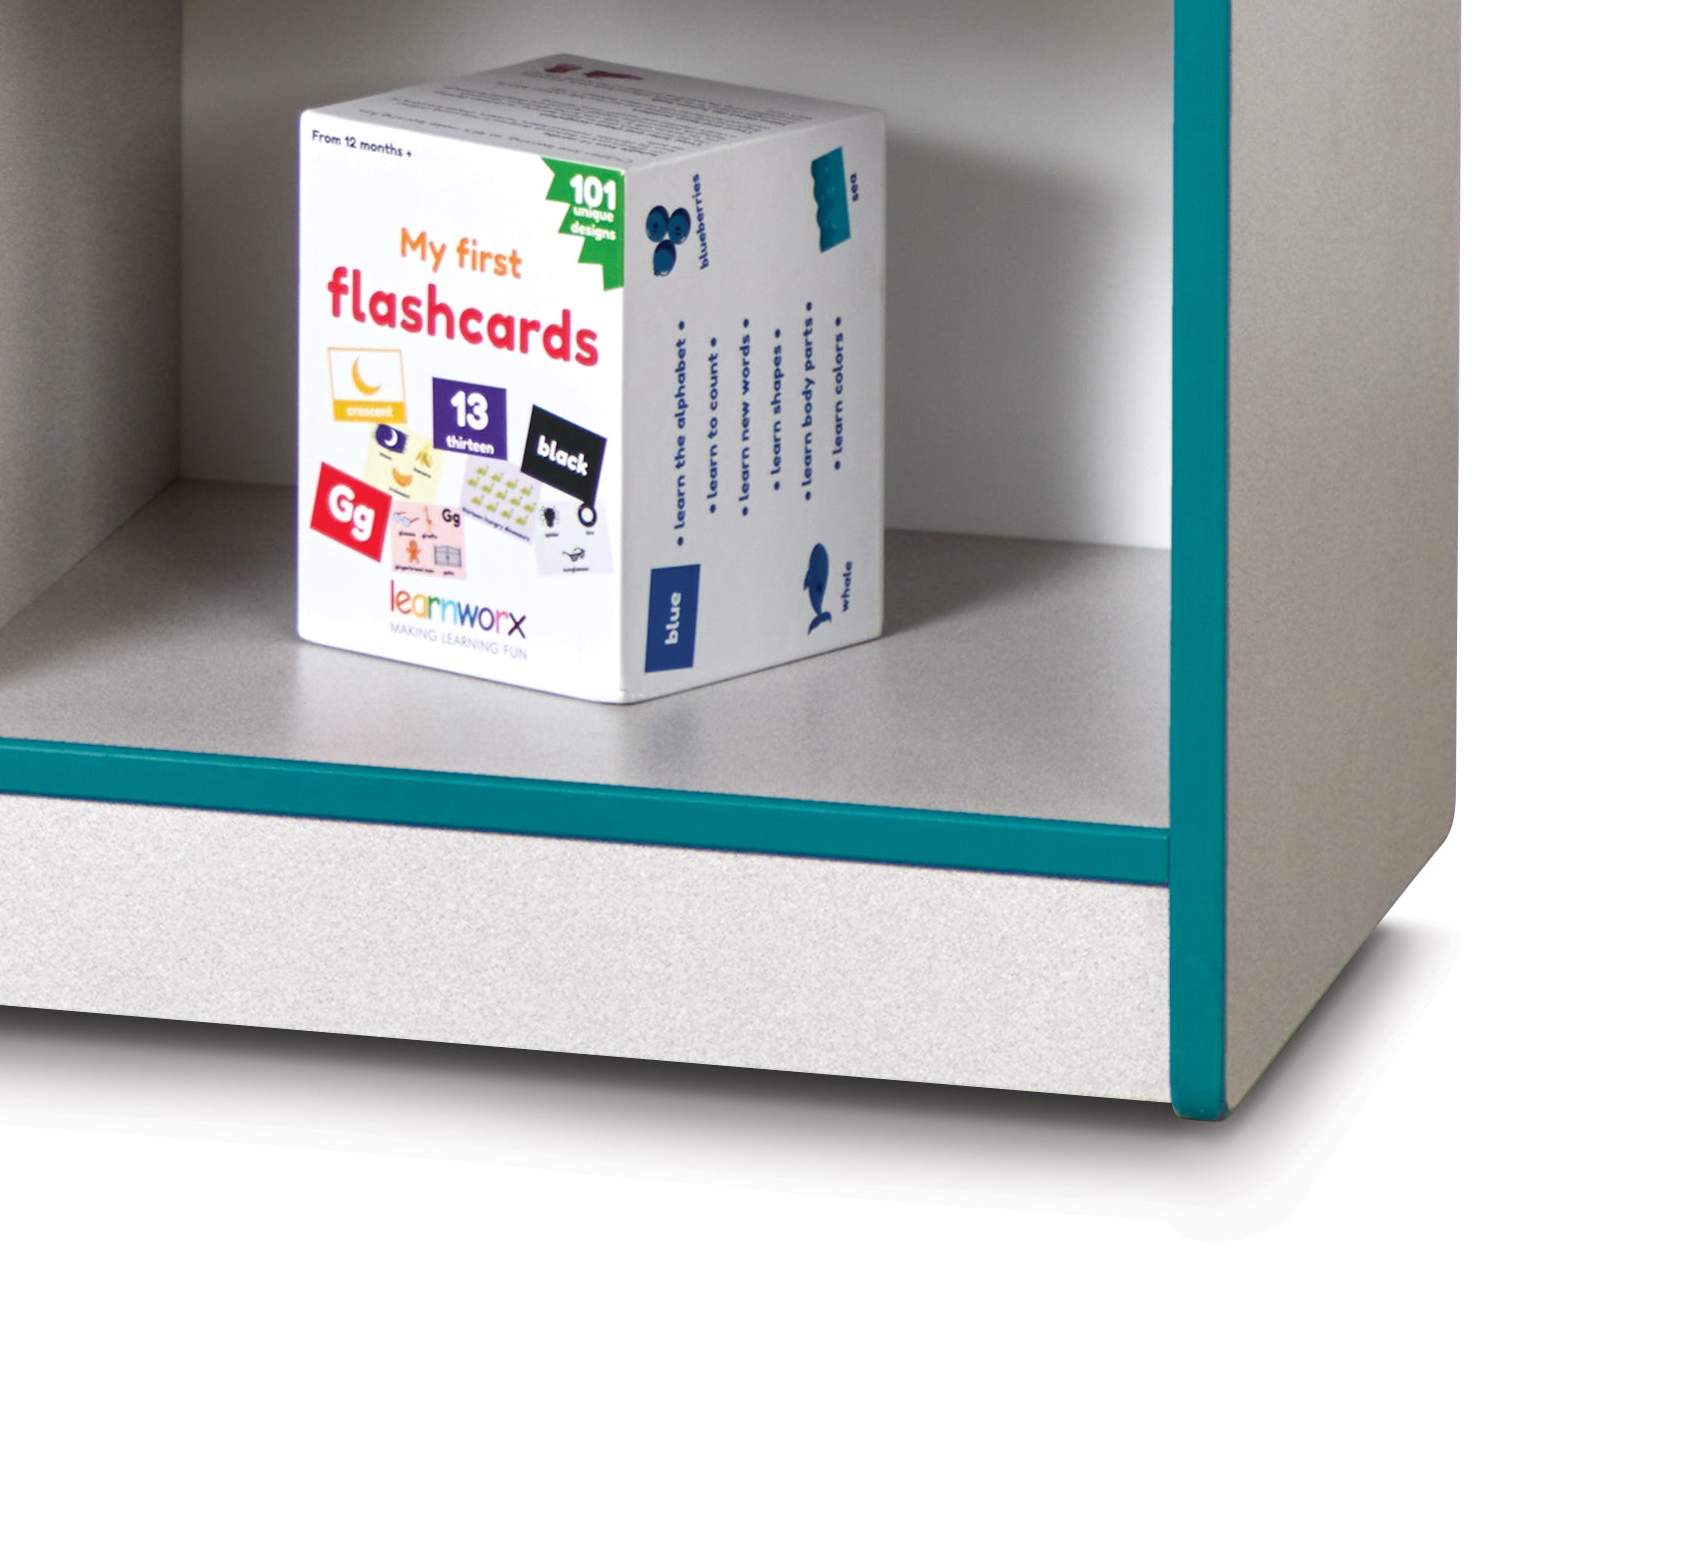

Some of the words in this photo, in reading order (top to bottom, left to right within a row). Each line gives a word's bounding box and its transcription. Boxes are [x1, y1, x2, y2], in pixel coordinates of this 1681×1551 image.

[312, 130, 341, 146] From
[345, 135, 357, 148] 12
[360, 140, 403, 157] months
[569, 174, 617, 211] 101
[850, 173, 859, 202] sea
[570, 220, 617, 241] designs
[573, 205, 614, 224] unique
[692, 173, 709, 270] blueberries
[401, 227, 446, 273] My
[457, 237, 522, 279] first
[327, 266, 599, 367] flashcards
[739, 334, 750, 395] words
[803, 317, 815, 371] parts
[833, 332, 844, 395] colors
[674, 338, 689, 429] alphabet
[708, 352, 718, 411] count
[771, 345, 784, 414] shapes
[802, 377, 815, 428] body
[346, 405, 394, 418] crescent
[450, 390, 489, 431] 13
[708, 417, 718, 440] to
[741, 401, 750, 442] new
[832, 400, 843, 455] learn
[445, 435, 495, 455] thirteen
[537, 435, 589, 476] black
[674, 435, 686, 470] the
[707, 444, 718, 499] learn
[770, 420, 781, 475] learn
[802, 432, 812, 486] learn
[739, 447, 750, 502] learn
[328, 484, 376, 542] Gg
[442, 508, 461, 528] Gg
[674, 475, 686, 530] learn
[390, 580, 527, 639] learnworx
[841, 561, 853, 613] whale
[390, 622, 437, 642] MAKING
[441, 632, 499, 655] LEARNING
[503, 644, 528, 660] FUN
[664, 591, 681, 645] blue
